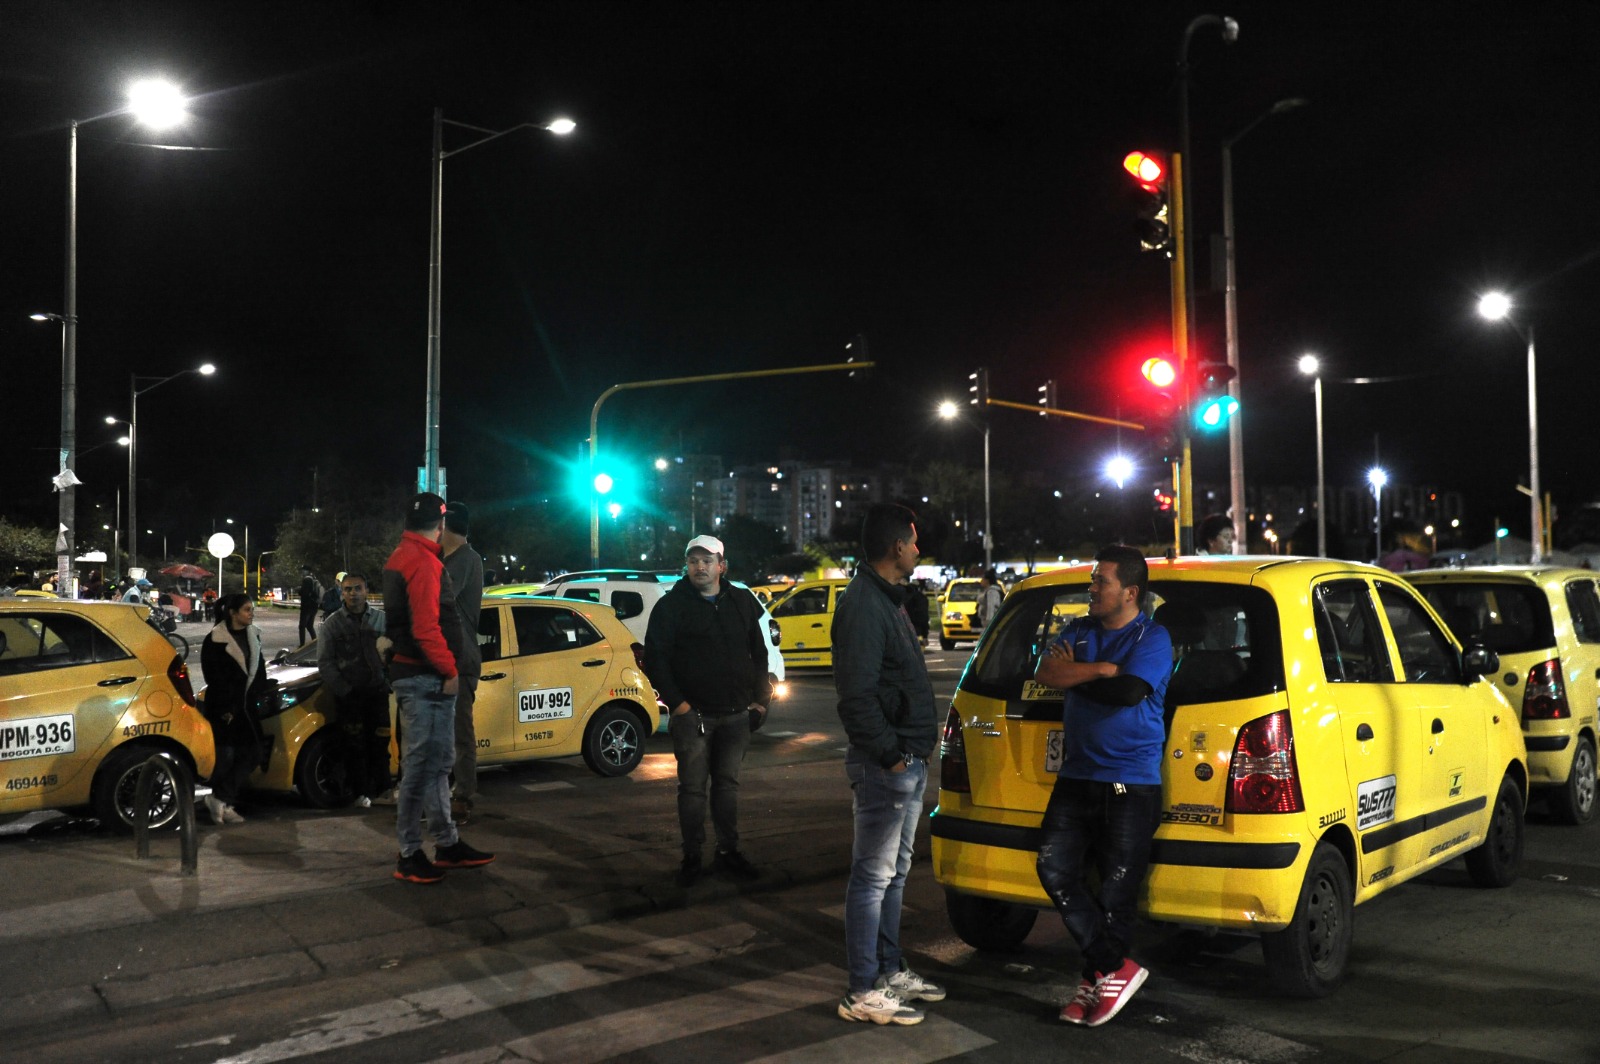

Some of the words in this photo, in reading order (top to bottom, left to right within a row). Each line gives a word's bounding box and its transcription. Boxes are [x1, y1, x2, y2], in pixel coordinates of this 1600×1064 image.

[609, 687, 638, 697] 4111111
[520, 694, 545, 711] GUV
[548, 691, 571, 708] 992
[527, 712, 552, 720] BOGOTA
[35, 721, 72, 745] 936
[123, 720, 171, 737] 4307777
[524, 731, 547, 742] 13667
[1, 748, 42, 759] BOGOTA
[45, 746, 64, 754] D.C.
[5, 775, 47, 791] 46944
[1357, 785, 1396, 816] SWS777
